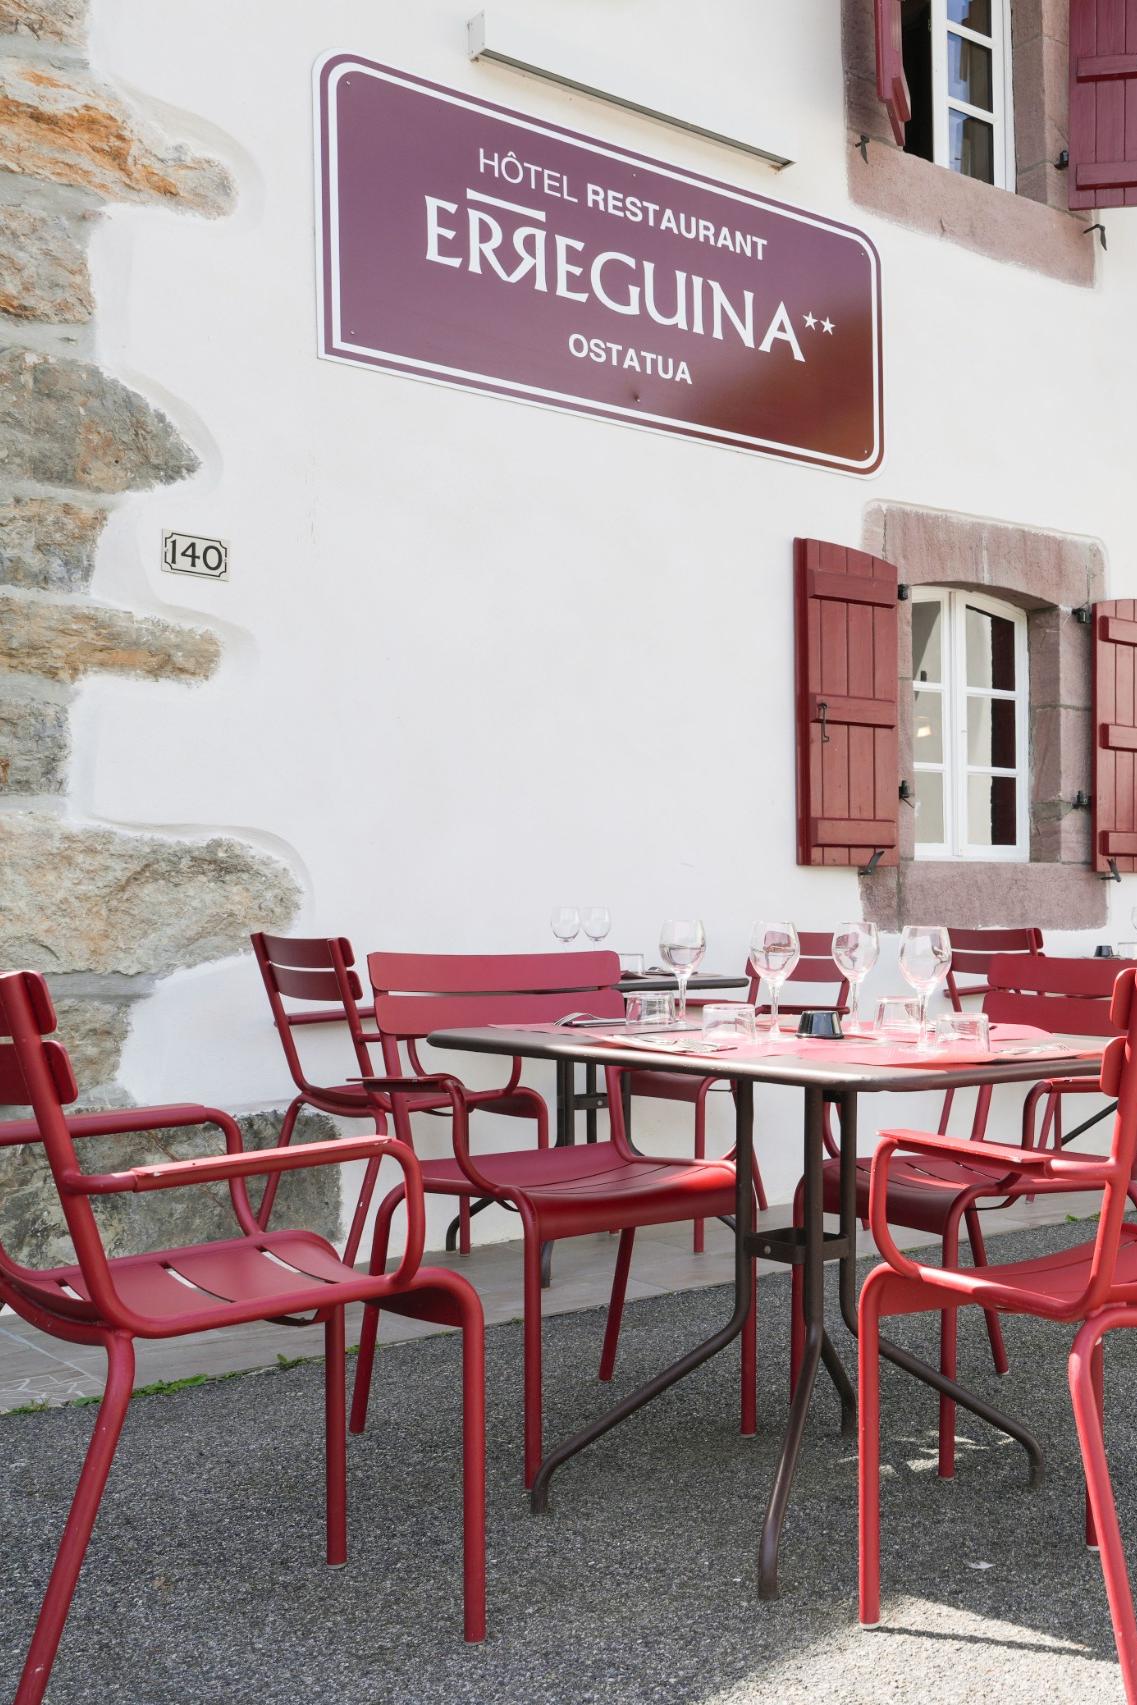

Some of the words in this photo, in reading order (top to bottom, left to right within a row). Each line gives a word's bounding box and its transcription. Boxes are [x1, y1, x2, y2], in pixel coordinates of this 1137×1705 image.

[479, 147, 579, 203] HÔTEL
[587, 183, 768, 261] RESTAURANT
[568, 333, 693, 385] OSTATUA
[170, 538, 223, 571] 140
